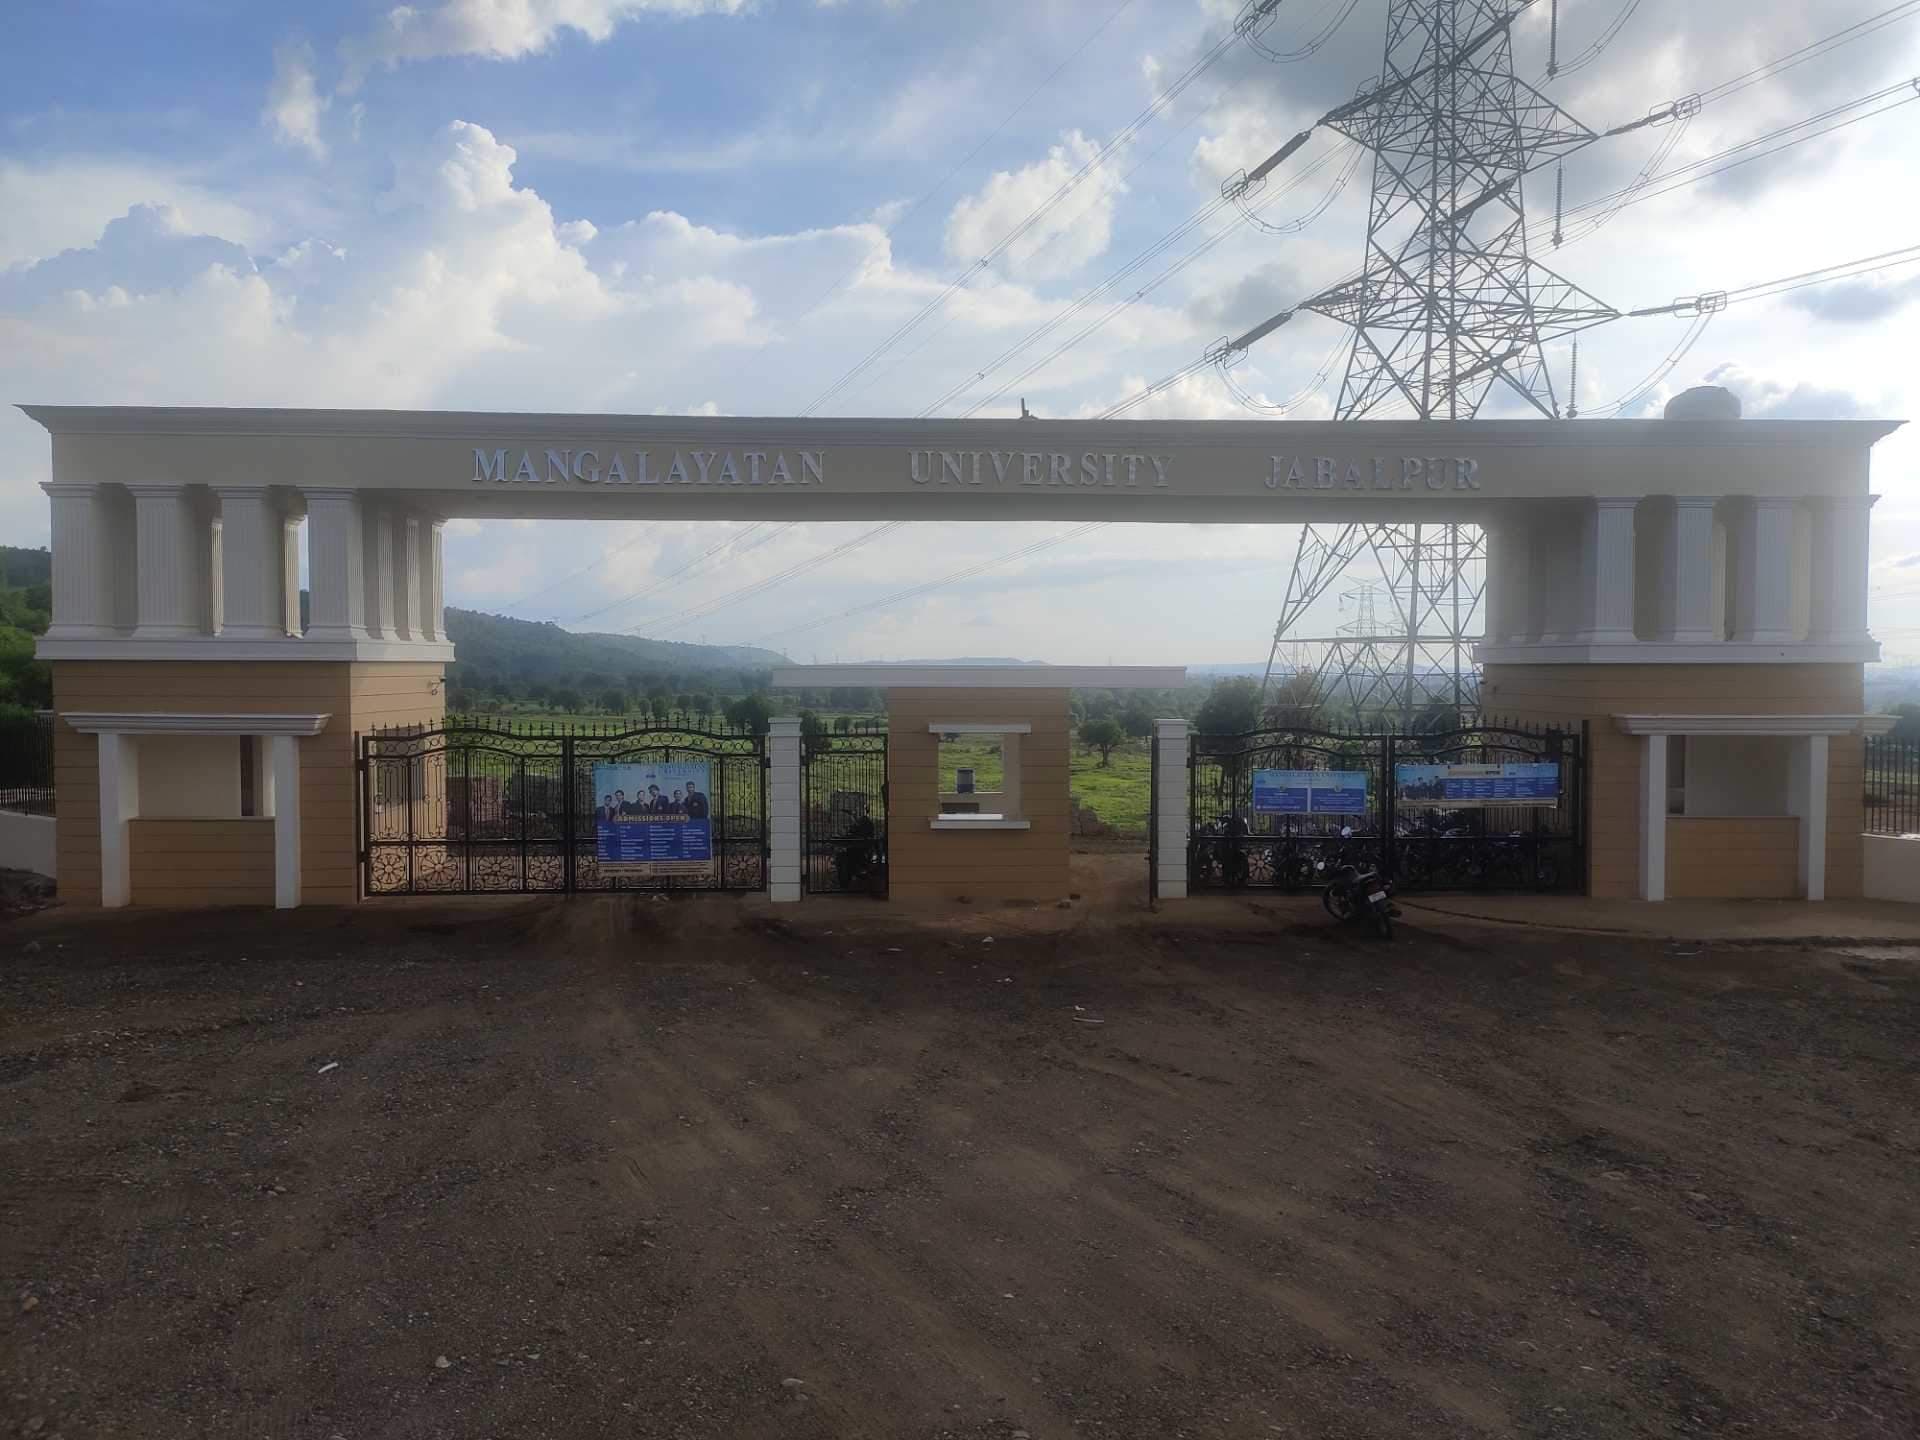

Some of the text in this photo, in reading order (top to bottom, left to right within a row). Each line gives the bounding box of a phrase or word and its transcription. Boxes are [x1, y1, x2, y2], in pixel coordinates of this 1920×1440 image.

[472, 448, 1481, 490] MANGALAYATAN UNIVERSITY JABALPUR
